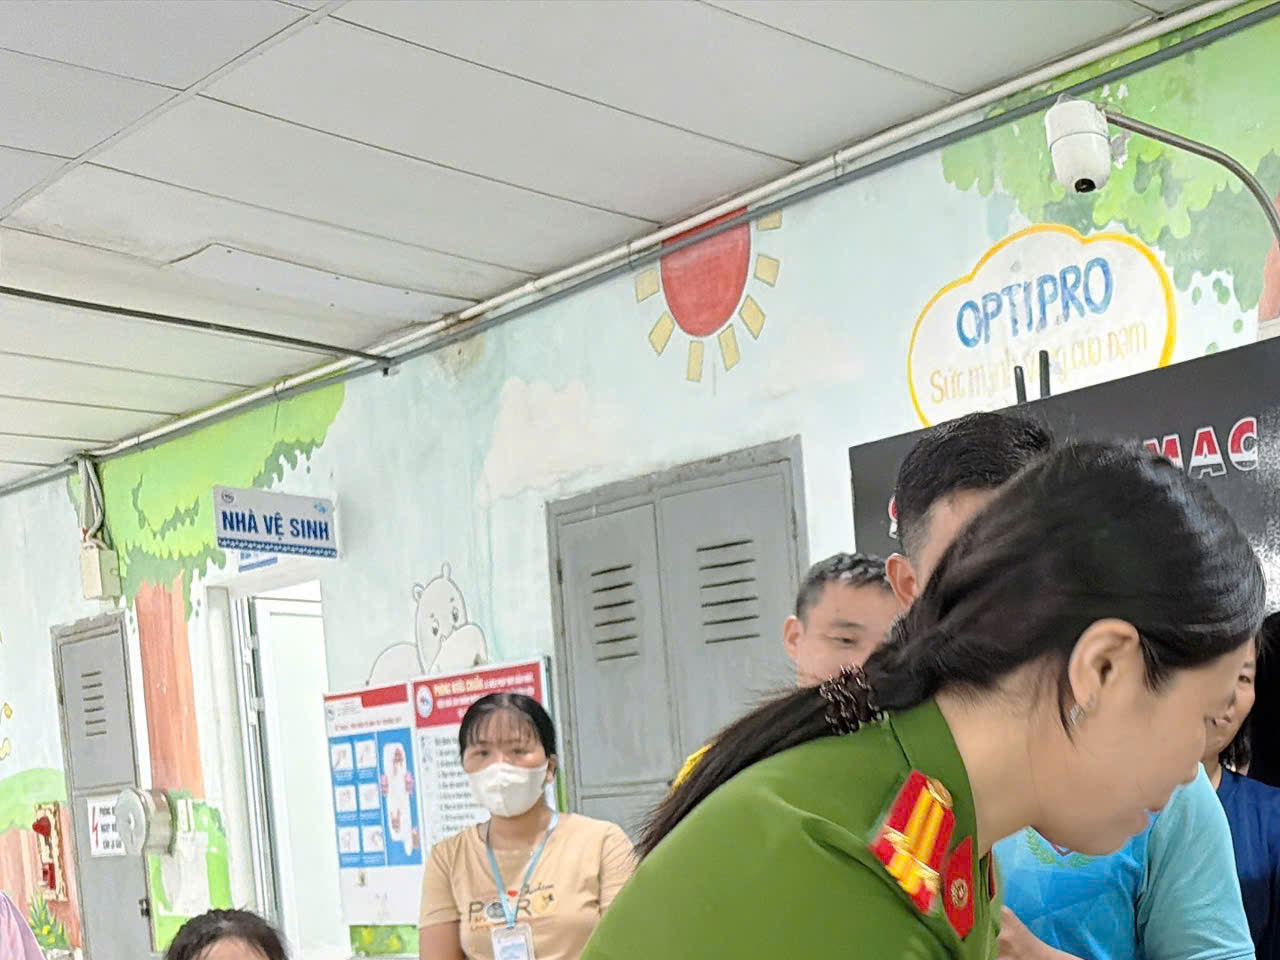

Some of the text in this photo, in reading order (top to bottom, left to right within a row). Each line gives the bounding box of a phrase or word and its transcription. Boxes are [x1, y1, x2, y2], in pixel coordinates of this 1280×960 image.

[957, 256, 1112, 348] OPTIPRO
[1143, 416, 1258, 480] MAC
[222, 508, 329, 541] NHÀ VỆ SINH
